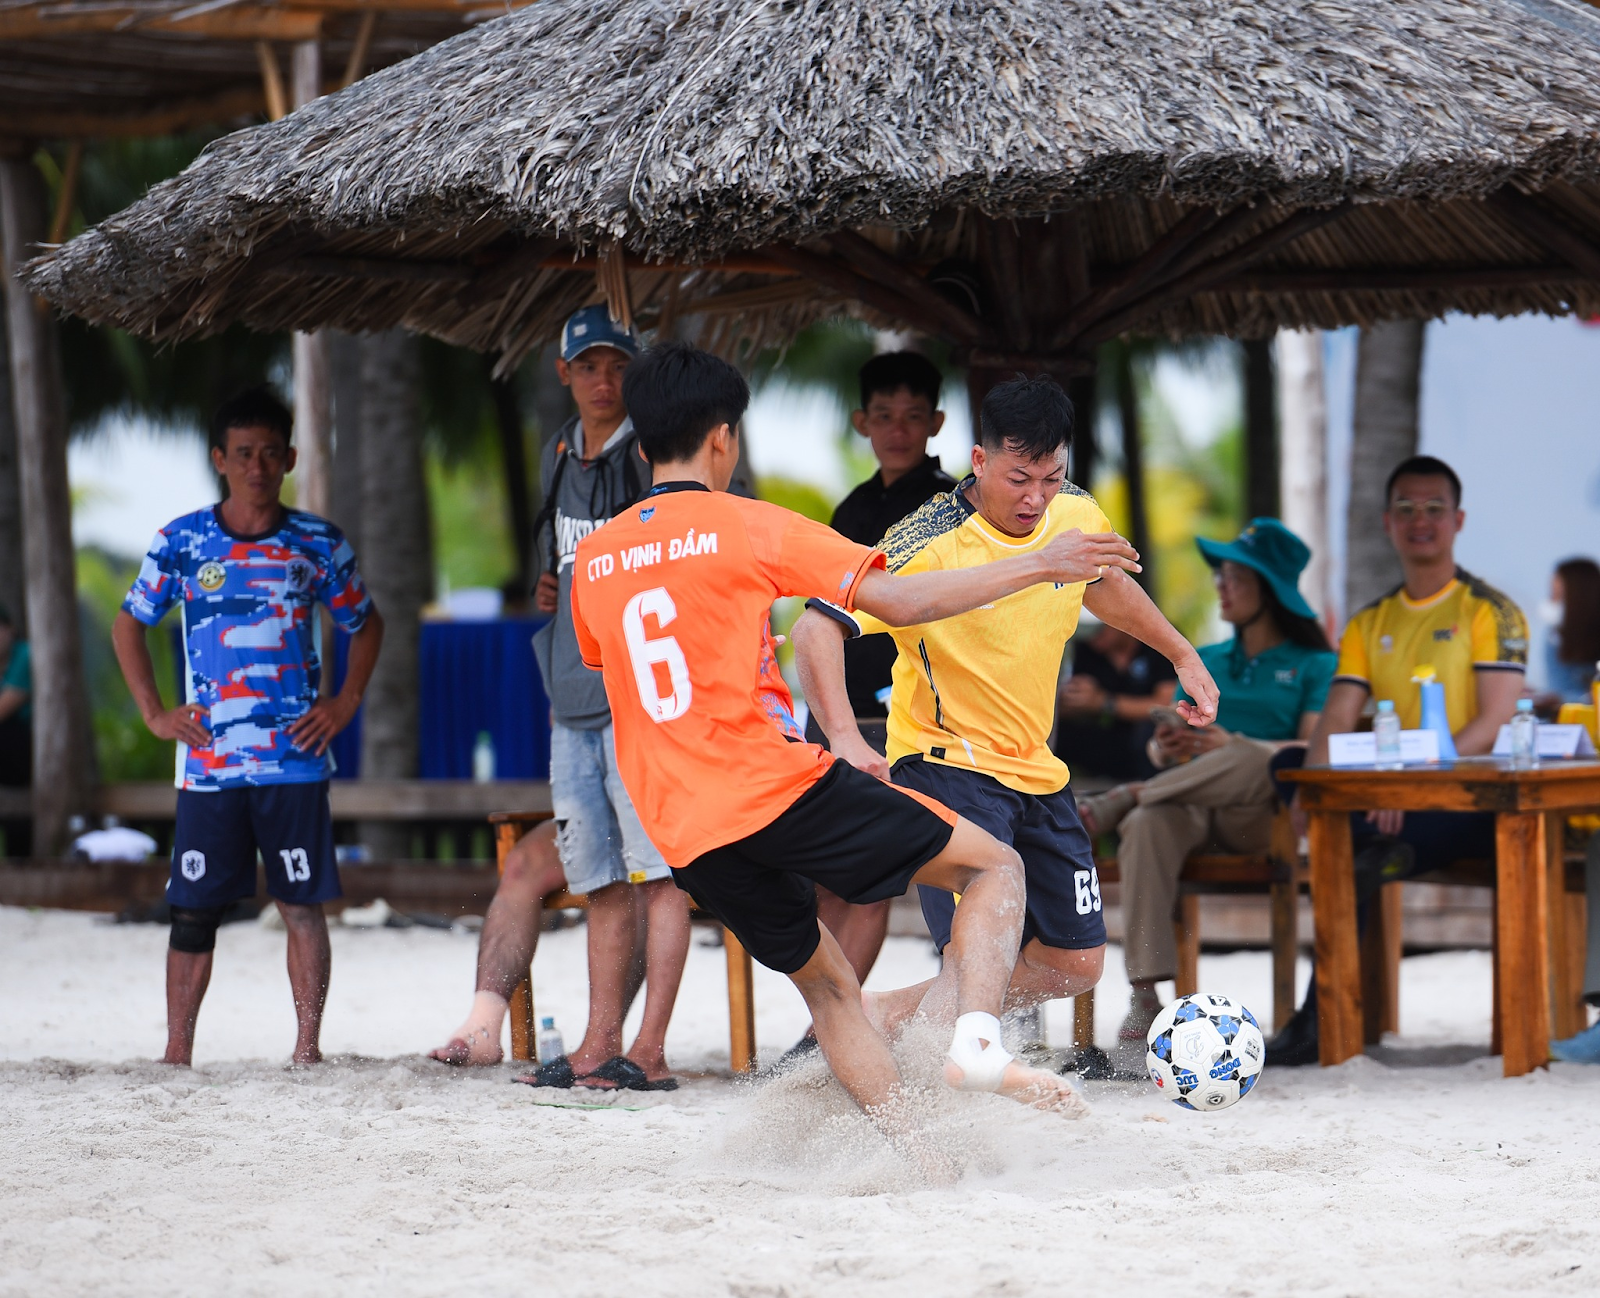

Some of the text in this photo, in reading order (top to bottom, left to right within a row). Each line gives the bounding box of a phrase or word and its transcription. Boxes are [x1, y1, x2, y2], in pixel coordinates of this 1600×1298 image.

[587, 528, 718, 582] CTD VỊNH ĐẦM
[622, 586, 693, 724] 6
[279, 847, 311, 883] 13
[1073, 866, 1102, 915] 69
[1175, 1057, 1242, 1086] DONG LUC
